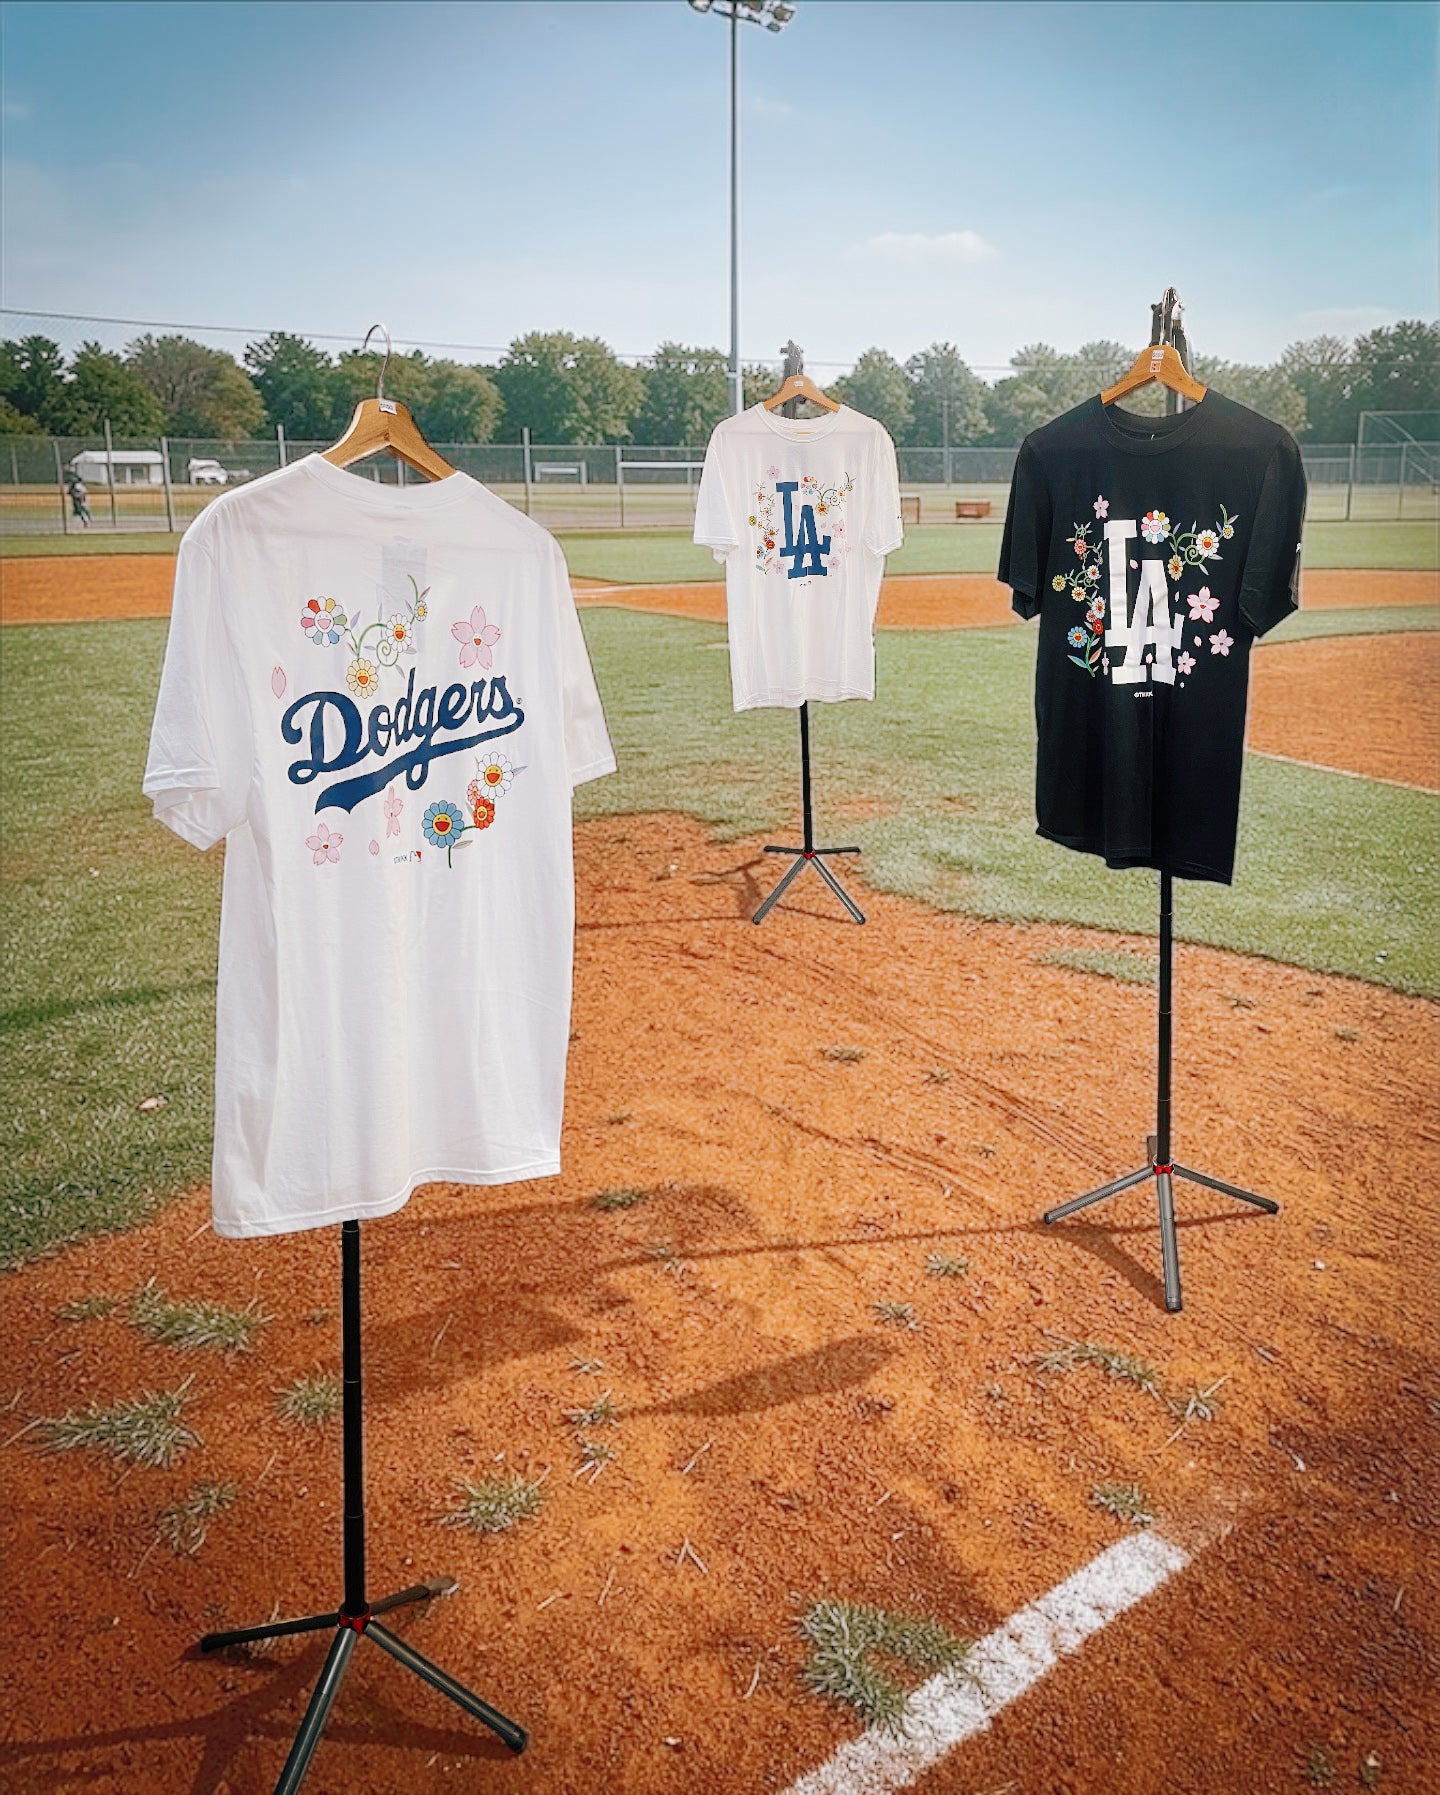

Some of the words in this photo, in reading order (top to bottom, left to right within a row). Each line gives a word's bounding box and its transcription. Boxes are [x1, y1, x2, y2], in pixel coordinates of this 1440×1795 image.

[776, 482, 831, 579] LA
[1103, 520, 1185, 685] LA
[281, 667, 524, 792] Dodgers
